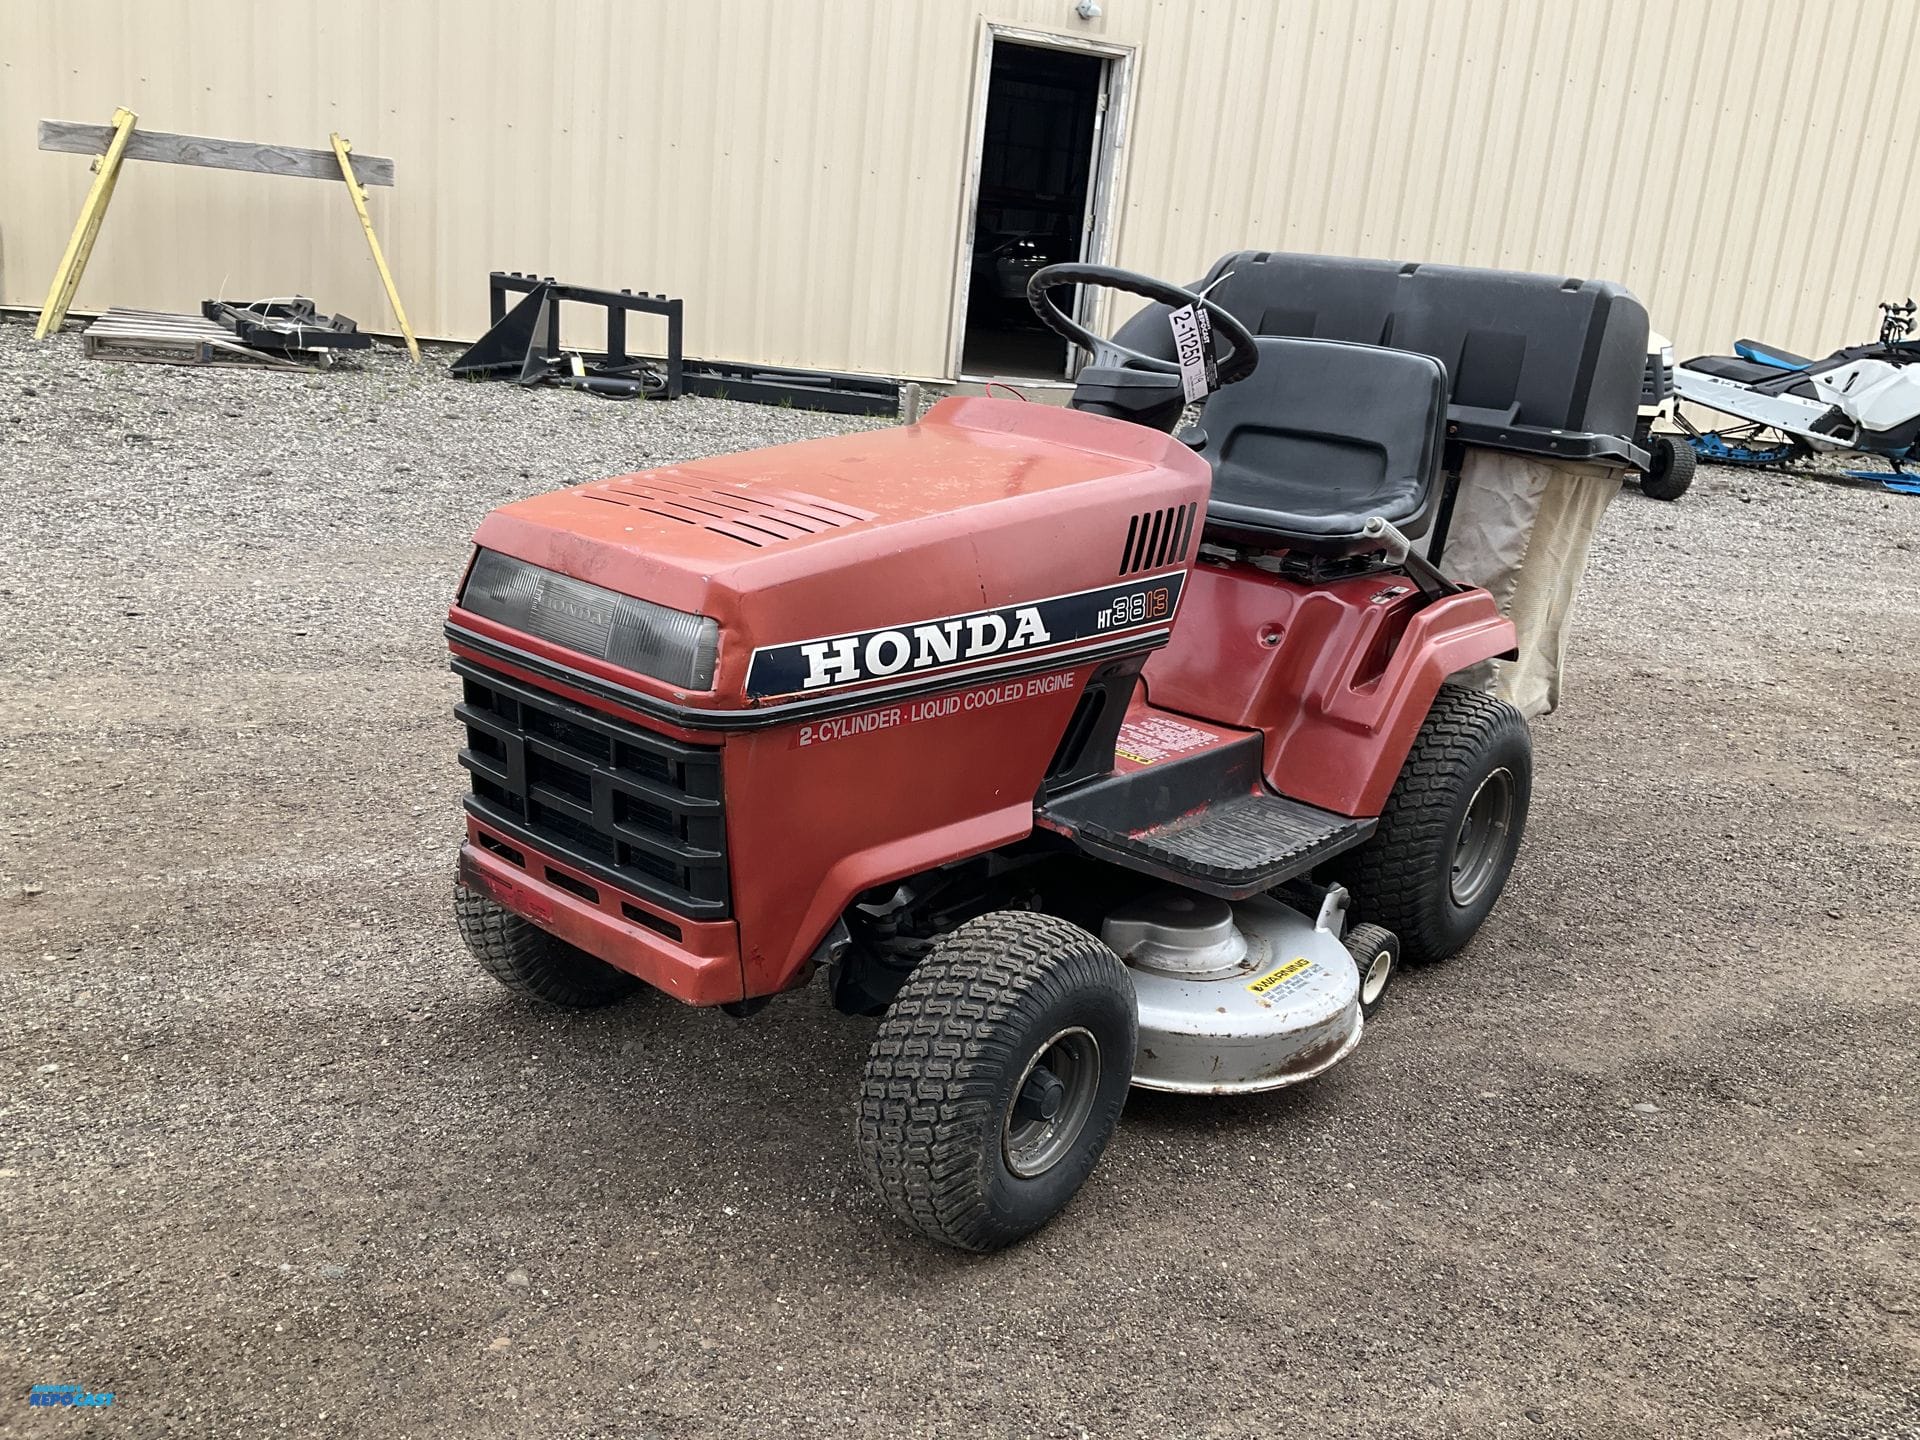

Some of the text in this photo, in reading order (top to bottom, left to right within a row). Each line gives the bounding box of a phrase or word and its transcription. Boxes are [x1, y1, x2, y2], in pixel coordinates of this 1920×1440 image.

[1173, 311, 1201, 367] 2-11250
[1097, 587, 1169, 629] HT3813
[800, 606, 1051, 689] HONDA
[799, 672, 1075, 747] 2-CYLINDER LIQUID COOLED ENGINE
[1260, 958, 1310, 988] WARNING
